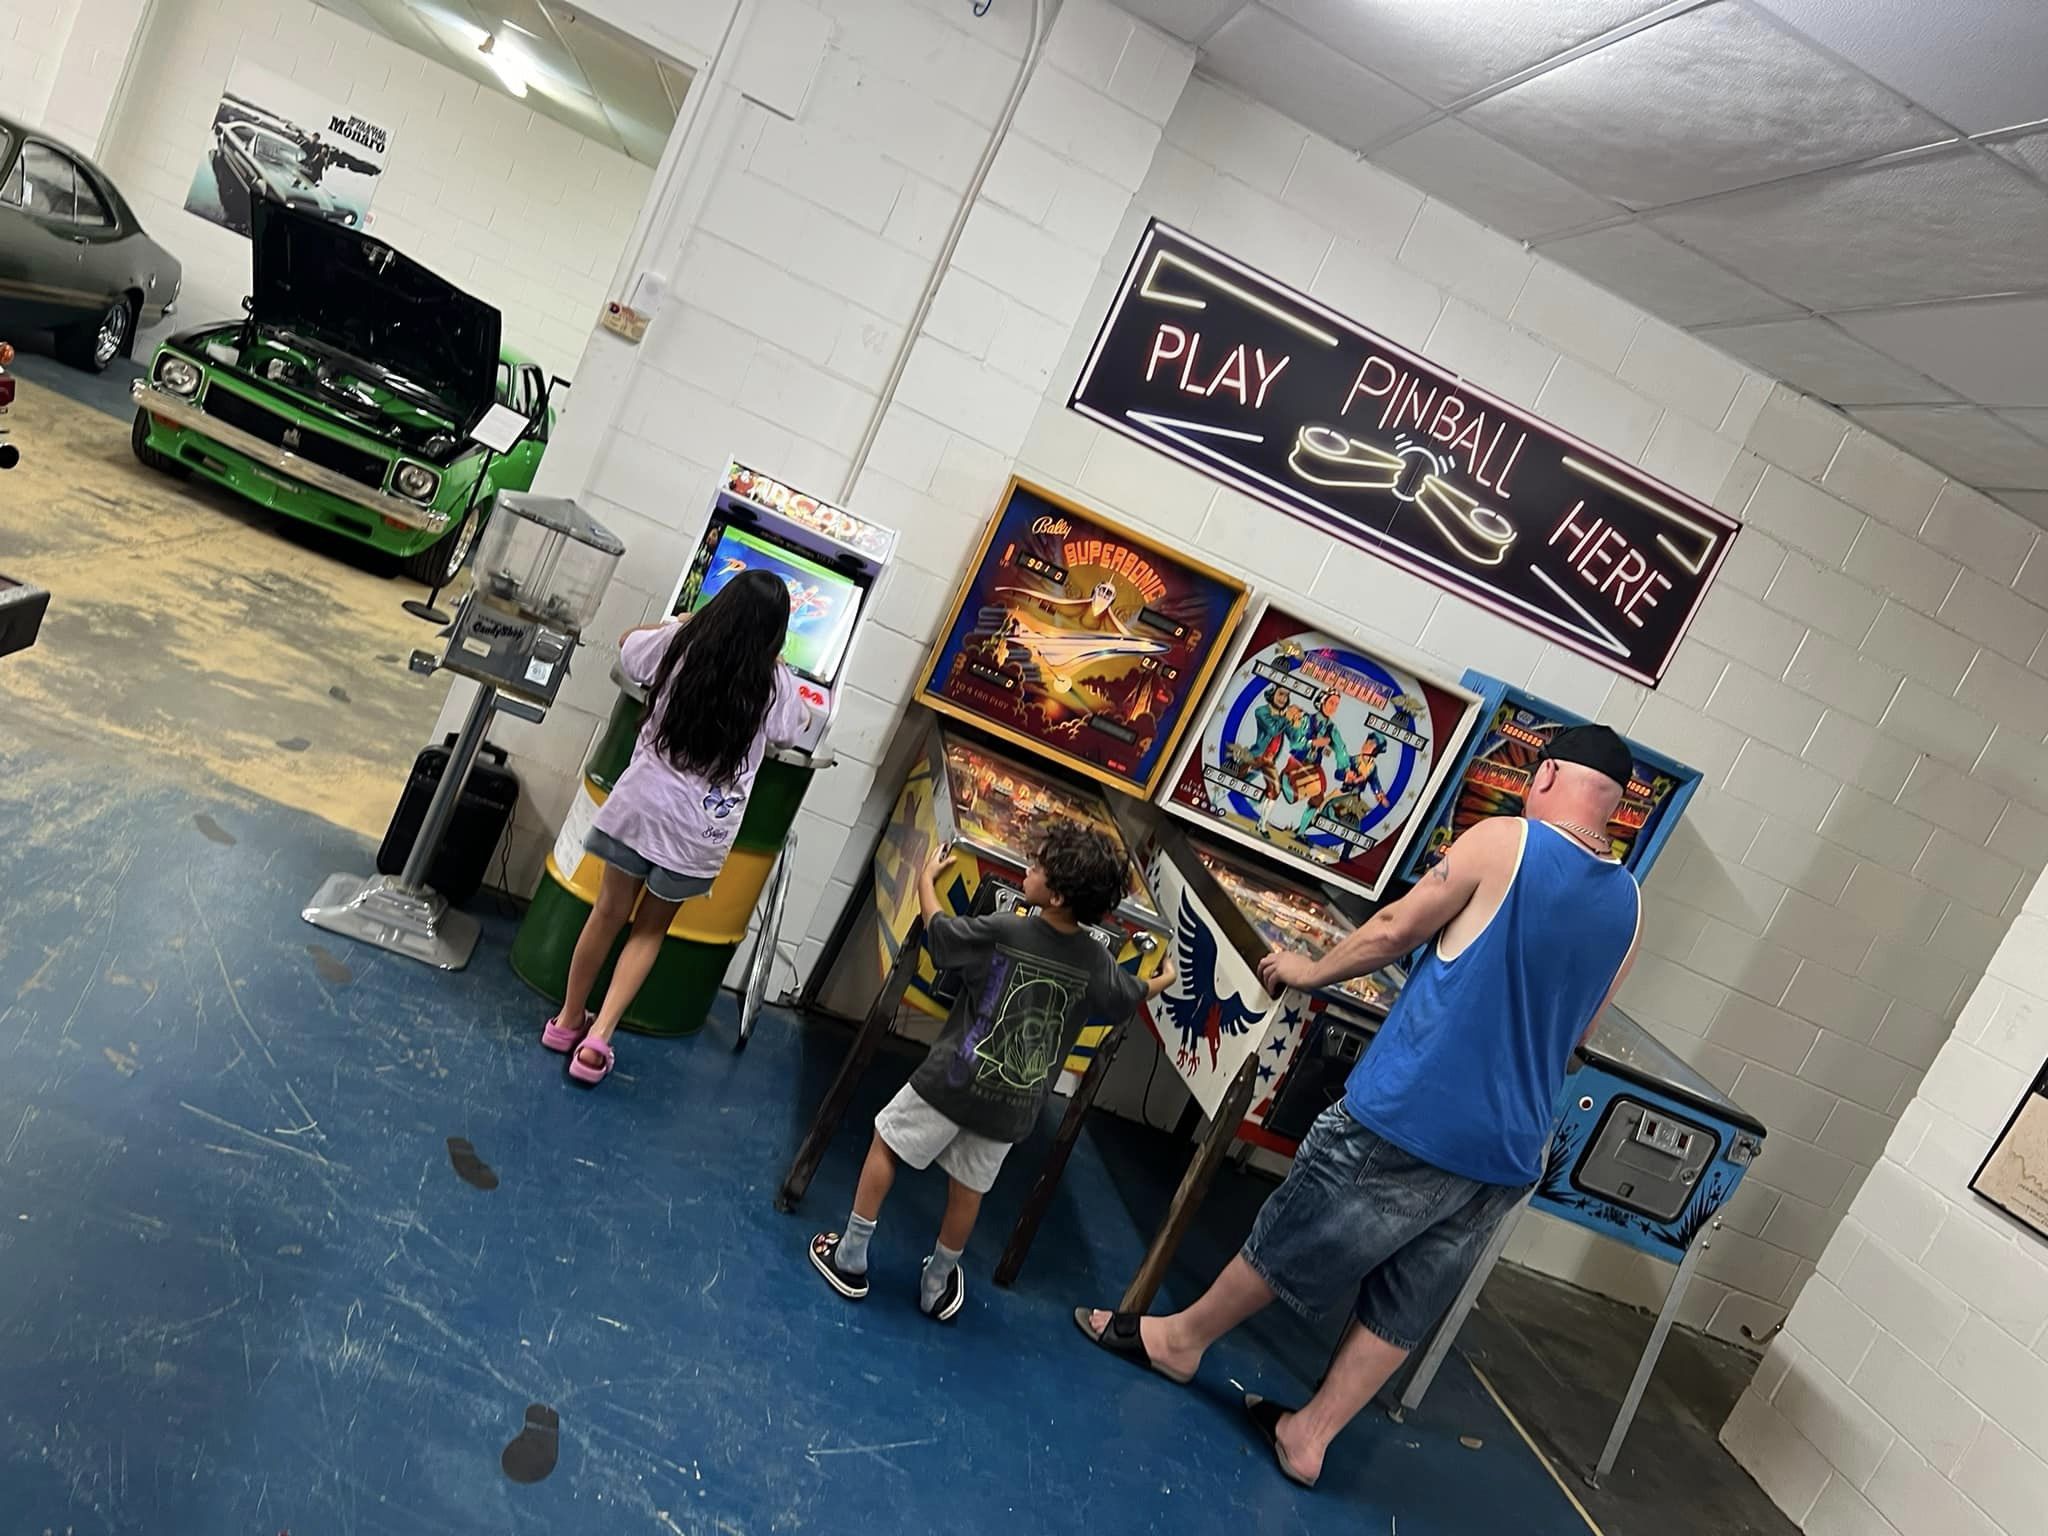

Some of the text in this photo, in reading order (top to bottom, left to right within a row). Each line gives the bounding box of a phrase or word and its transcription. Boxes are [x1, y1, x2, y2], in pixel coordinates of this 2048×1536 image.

[328, 115, 385, 153] Monaro
[1145, 323, 1673, 628] PLAY PINBALL HERE
[1031, 515, 1073, 541] Bally
[1063, 540, 1168, 605] SUPERSONIC
